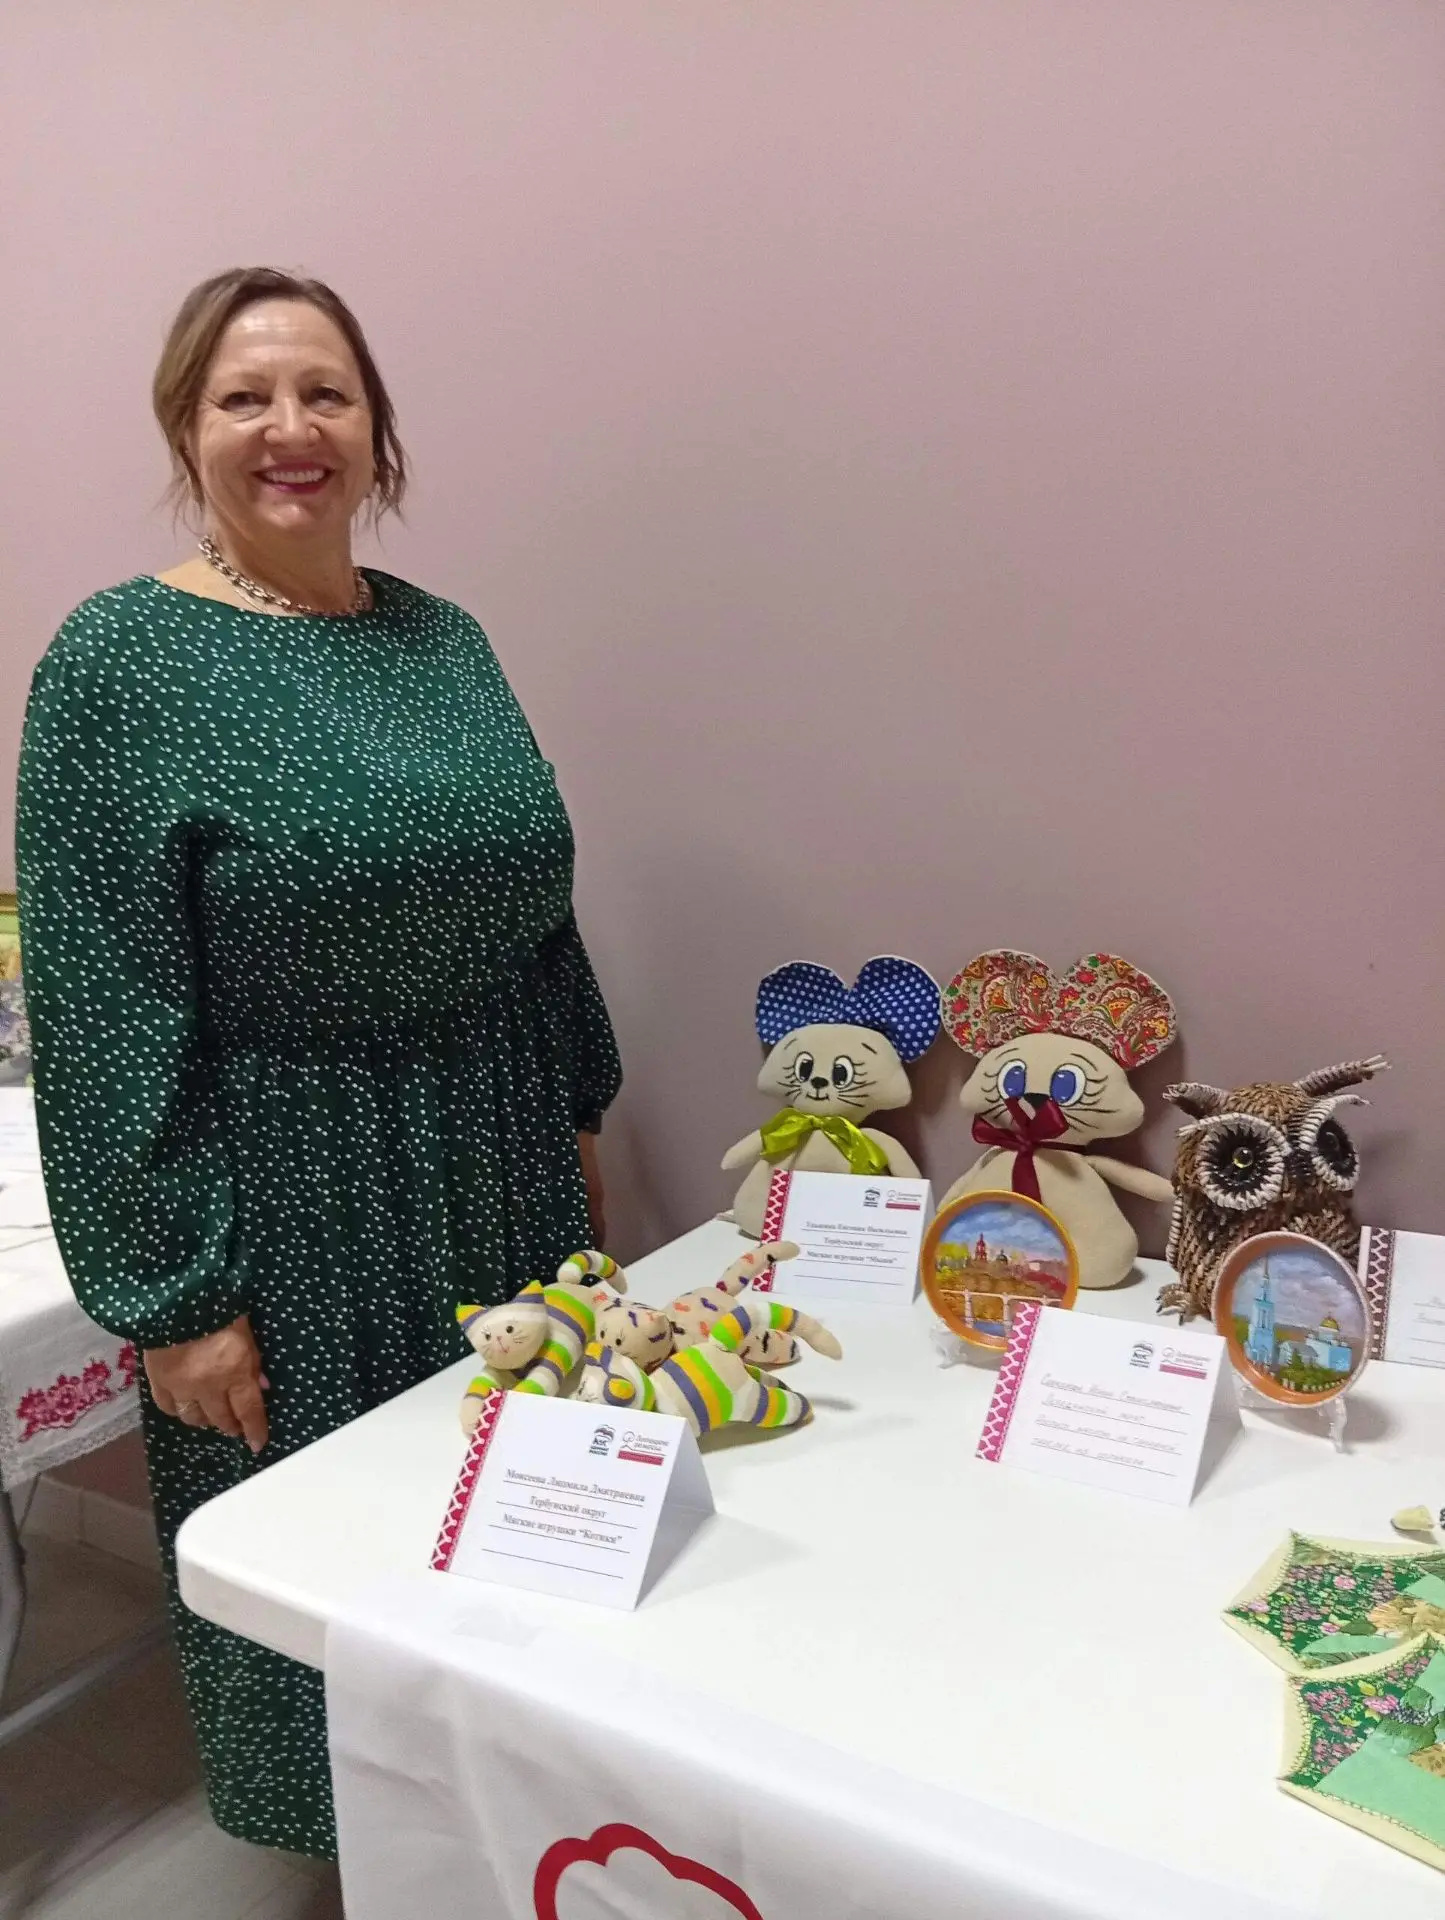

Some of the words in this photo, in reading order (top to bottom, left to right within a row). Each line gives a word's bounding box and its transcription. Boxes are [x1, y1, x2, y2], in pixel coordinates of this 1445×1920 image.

[547, 1476, 589, 1491] Людмила
[589, 1484, 646, 1502] Дмитриевна
[529, 1496, 579, 1514] Тербунский
[581, 1508, 607, 1519] округ
[503, 1514, 536, 1529] Мягкие
[537, 1521, 577, 1536] игрушки
